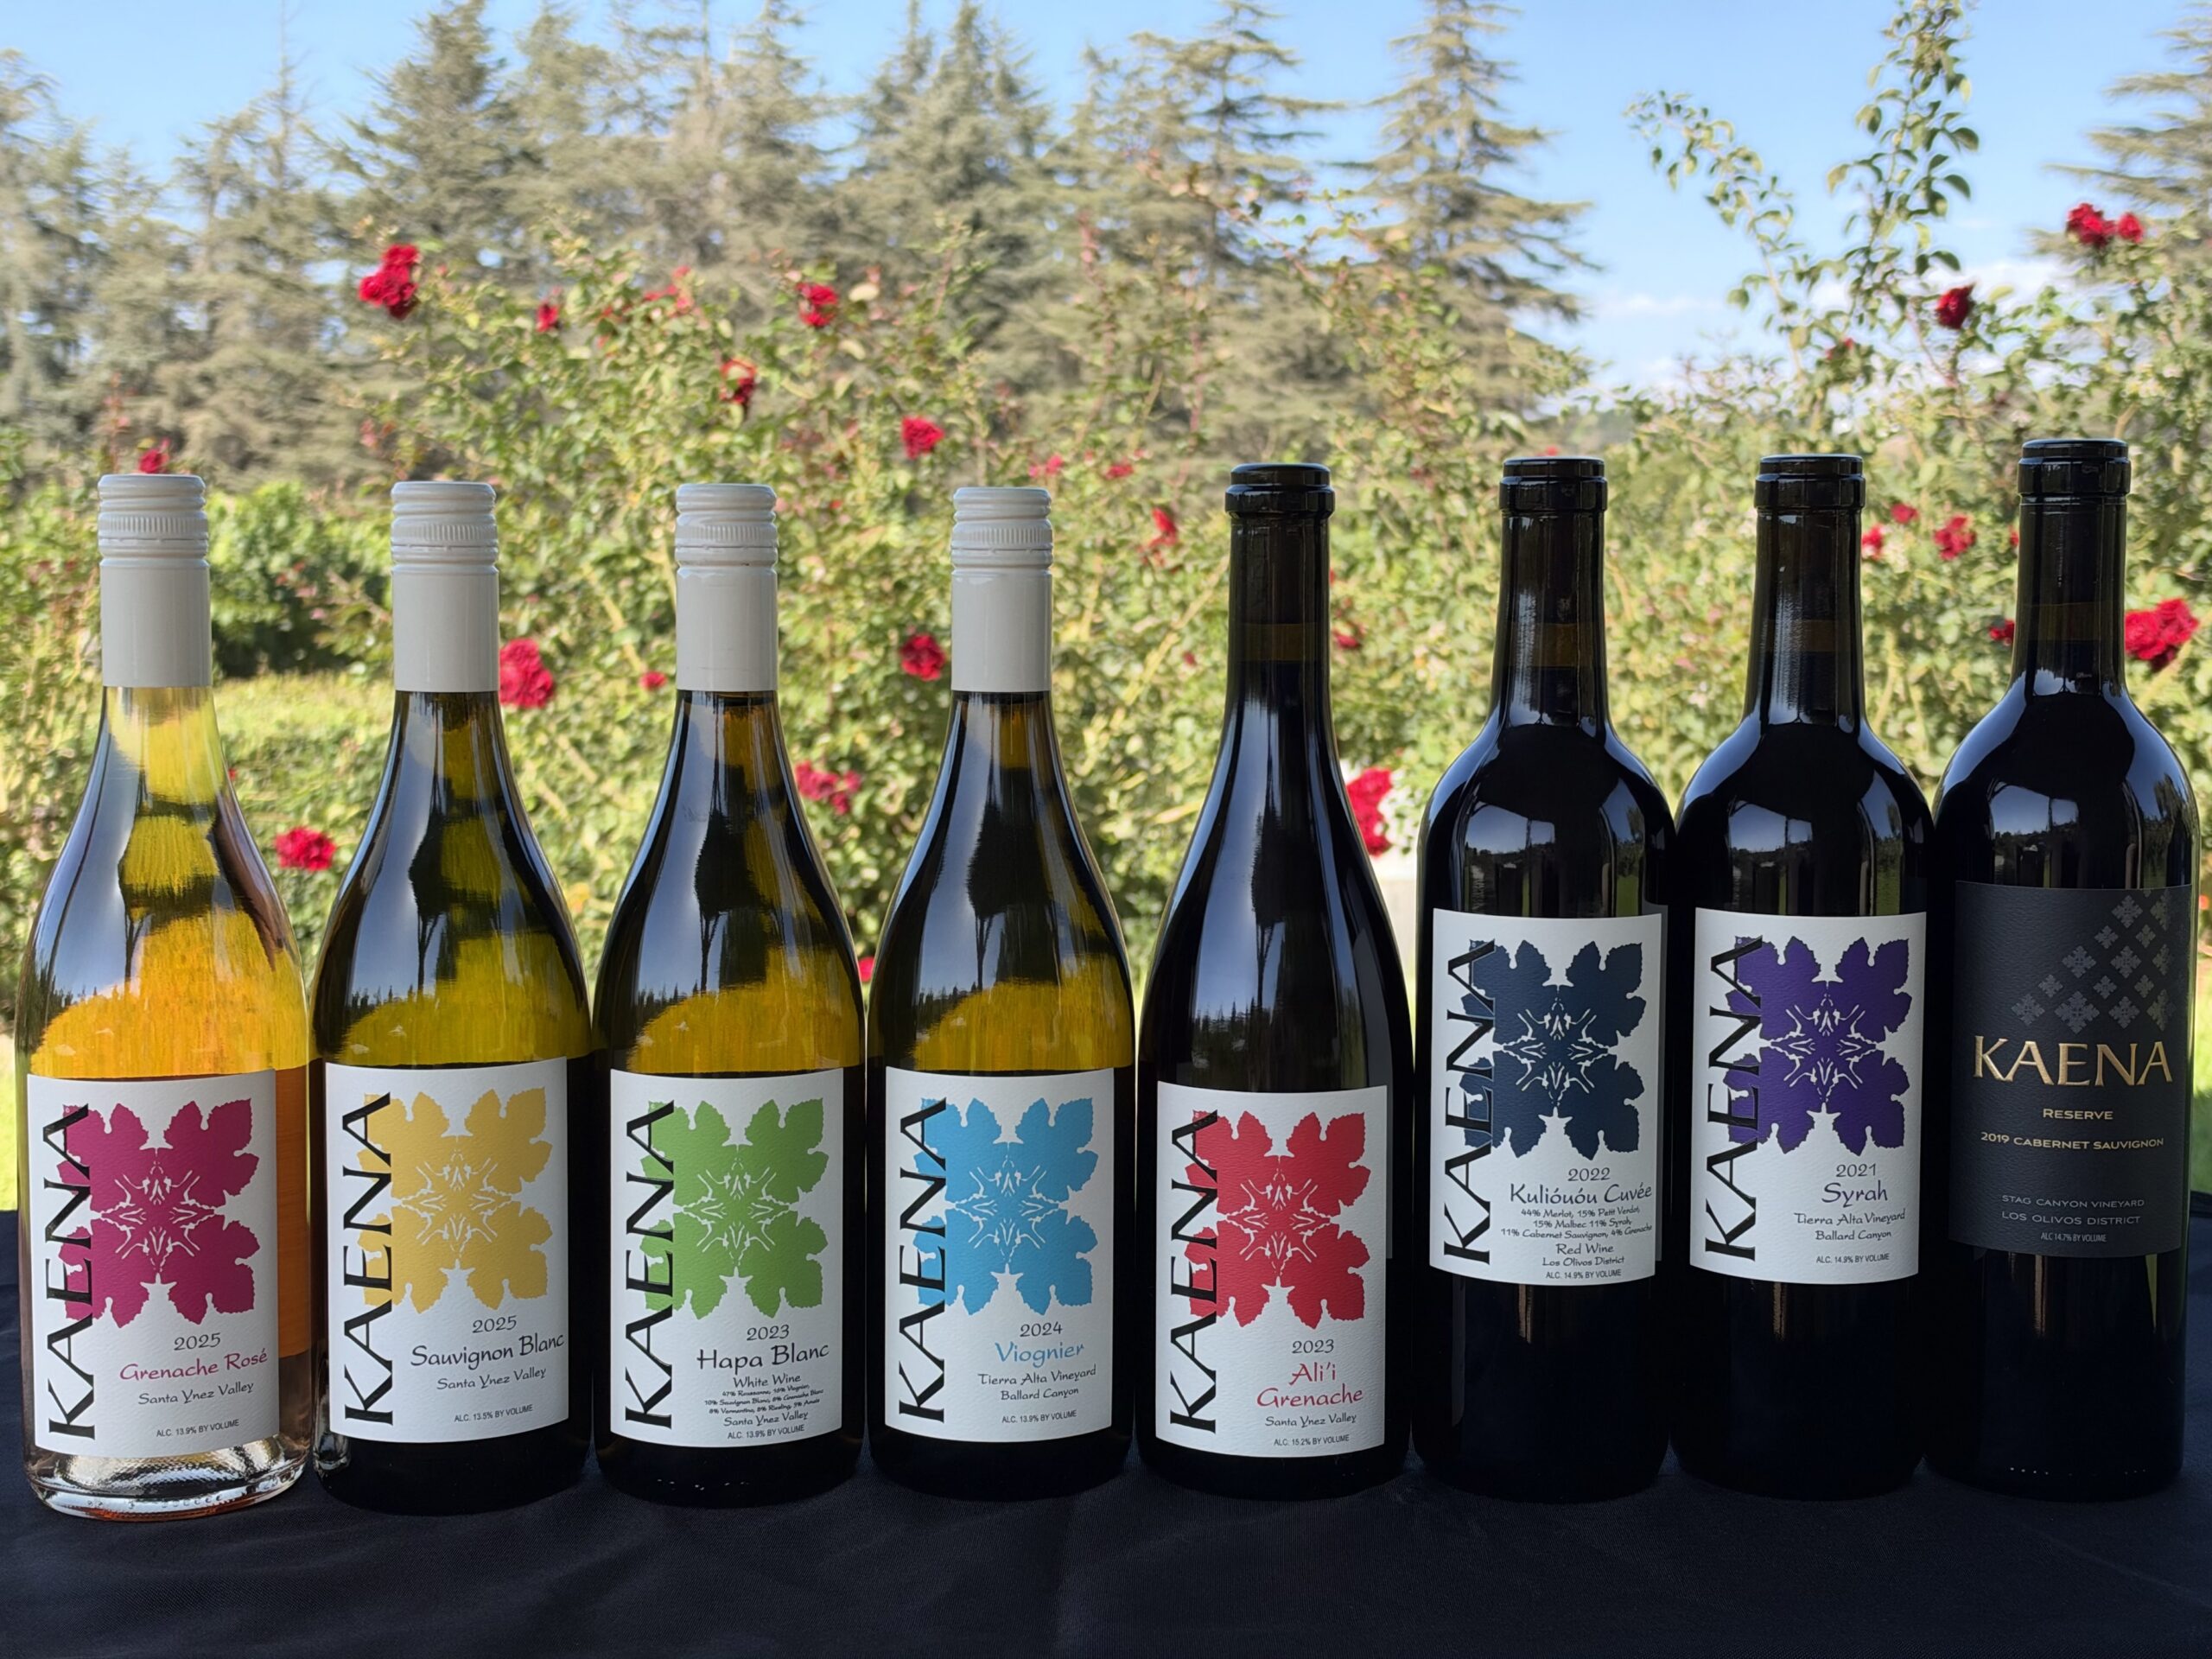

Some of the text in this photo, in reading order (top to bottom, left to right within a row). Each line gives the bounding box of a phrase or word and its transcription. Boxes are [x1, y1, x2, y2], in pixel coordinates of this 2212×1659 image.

[1973, 1035, 2173, 1086] KAENA
[1444, 938, 1496, 1265] KAENA
[1705, 935, 1763, 1262] KAENA
[2043, 1109, 2113, 1120] RESERVE
[1980, 1132, 2164, 1150] 2019 CABERNET SAUVIGNON
[1567, 1167, 1611, 1182] 2022
[1836, 1164, 1877, 1178] 2021
[1604, 1182, 1652, 1203] Cuvée
[1821, 1179, 1888, 1208] Syrah
[2002, 1195, 2145, 1208] STAG CANYON VINEYARD
[1543, 1208, 1573, 1218] Merlot,
[1794, 1208, 1906, 1226] Tierra Alta Vineyard
[2002, 1211, 2140, 1225] LOS OLIVOS DISTRICT
[1522, 1230, 1562, 1239] Cabernet
[1564, 1231, 1608, 1241] Sauvignon,
[1624, 1224, 1652, 1235] Grenache
[1554, 1220, 1587, 1229] Malbec
[1815, 1230, 1891, 1241] Ballard Canyon
[2082, 1234, 2107, 1243] VOLUME
[1556, 1243, 1615, 1255] Red Wine
[1866, 1253, 1890, 1262] VOLUME
[342, 1091, 393, 1426] KAENA
[625, 1099, 674, 1429] KAENA
[899, 1097, 947, 1423] KAENA
[1542, 1256, 1624, 1267] Los Olivos District
[42, 1103, 95, 1440] KAENA
[1170, 1109, 1218, 1434] KAENA
[1596, 1269, 1621, 1278] VOLUME
[473, 1315, 517, 1333] 2025
[1020, 1321, 1063, 1338] 2024
[174, 1332, 220, 1351] 2025
[747, 1325, 789, 1341] 2023
[410, 1332, 564, 1370] Sauvignon Blanc
[995, 1341, 1084, 1368] Viognier
[1292, 1339, 1334, 1354] 2023
[120, 1348, 268, 1381] Grenache Rosé
[697, 1343, 830, 1376] Hapa Blanc
[436, 1367, 546, 1389] Santa Ynez Valley
[733, 1373, 801, 1388] White Wine
[978, 1363, 1096, 1385] Tierra Alta Vineyard
[138, 1382, 254, 1404] Santa Ynez Valley
[1001, 1388, 1079, 1400] Ballard Canyon
[1256, 1382, 1363, 1408] Grenache
[474, 1412, 493, 1421] 13.5%
[505, 1404, 532, 1415] VOLUME
[723, 1410, 808, 1427] Santa Ynez Valley
[1051, 1410, 1077, 1420] VOLUME
[1265, 1412, 1357, 1428] Santa Ynez Valley
[176, 1427, 196, 1435] 13.9%
[210, 1419, 239, 1431] VOLUME
[778, 1424, 804, 1434] VOLUME
[1323, 1434, 1350, 1444] VOLUME
